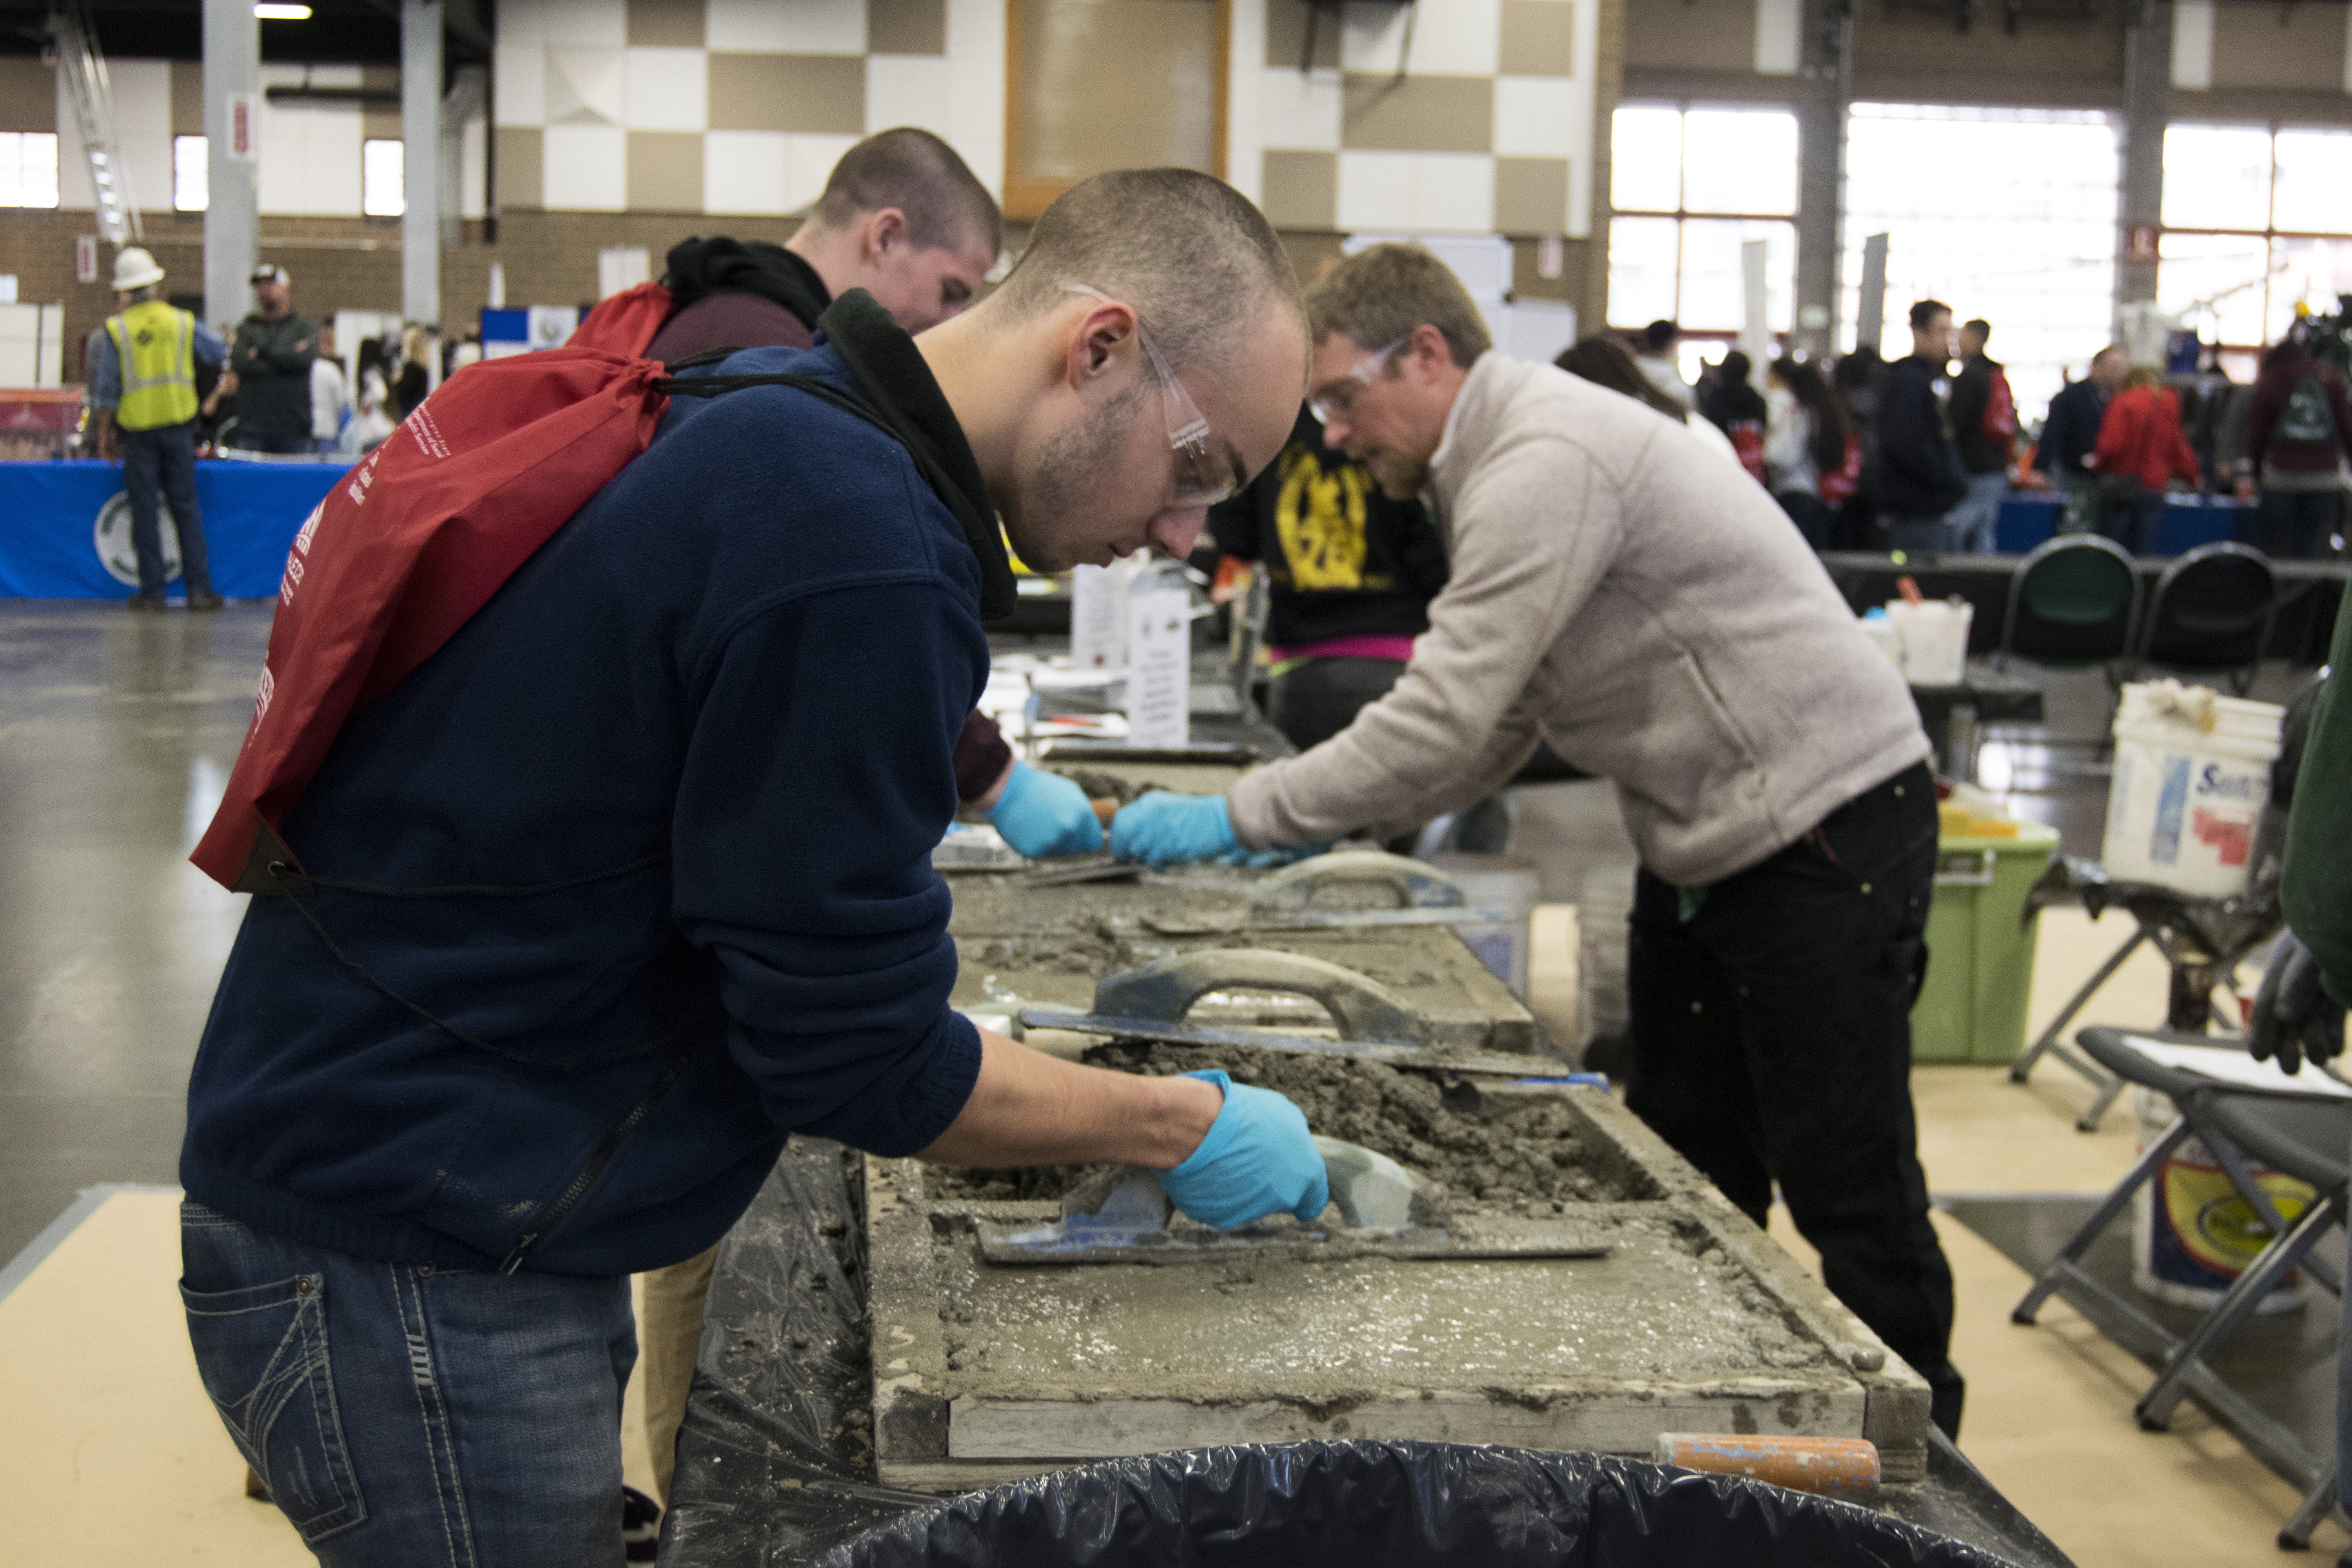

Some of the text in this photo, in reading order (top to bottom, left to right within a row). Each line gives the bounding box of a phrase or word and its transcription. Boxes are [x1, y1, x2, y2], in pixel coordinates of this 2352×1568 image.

[413, 409, 431, 437] epartment
[430, 443, 446, 458] Social
[414, 433, 430, 455] Services
